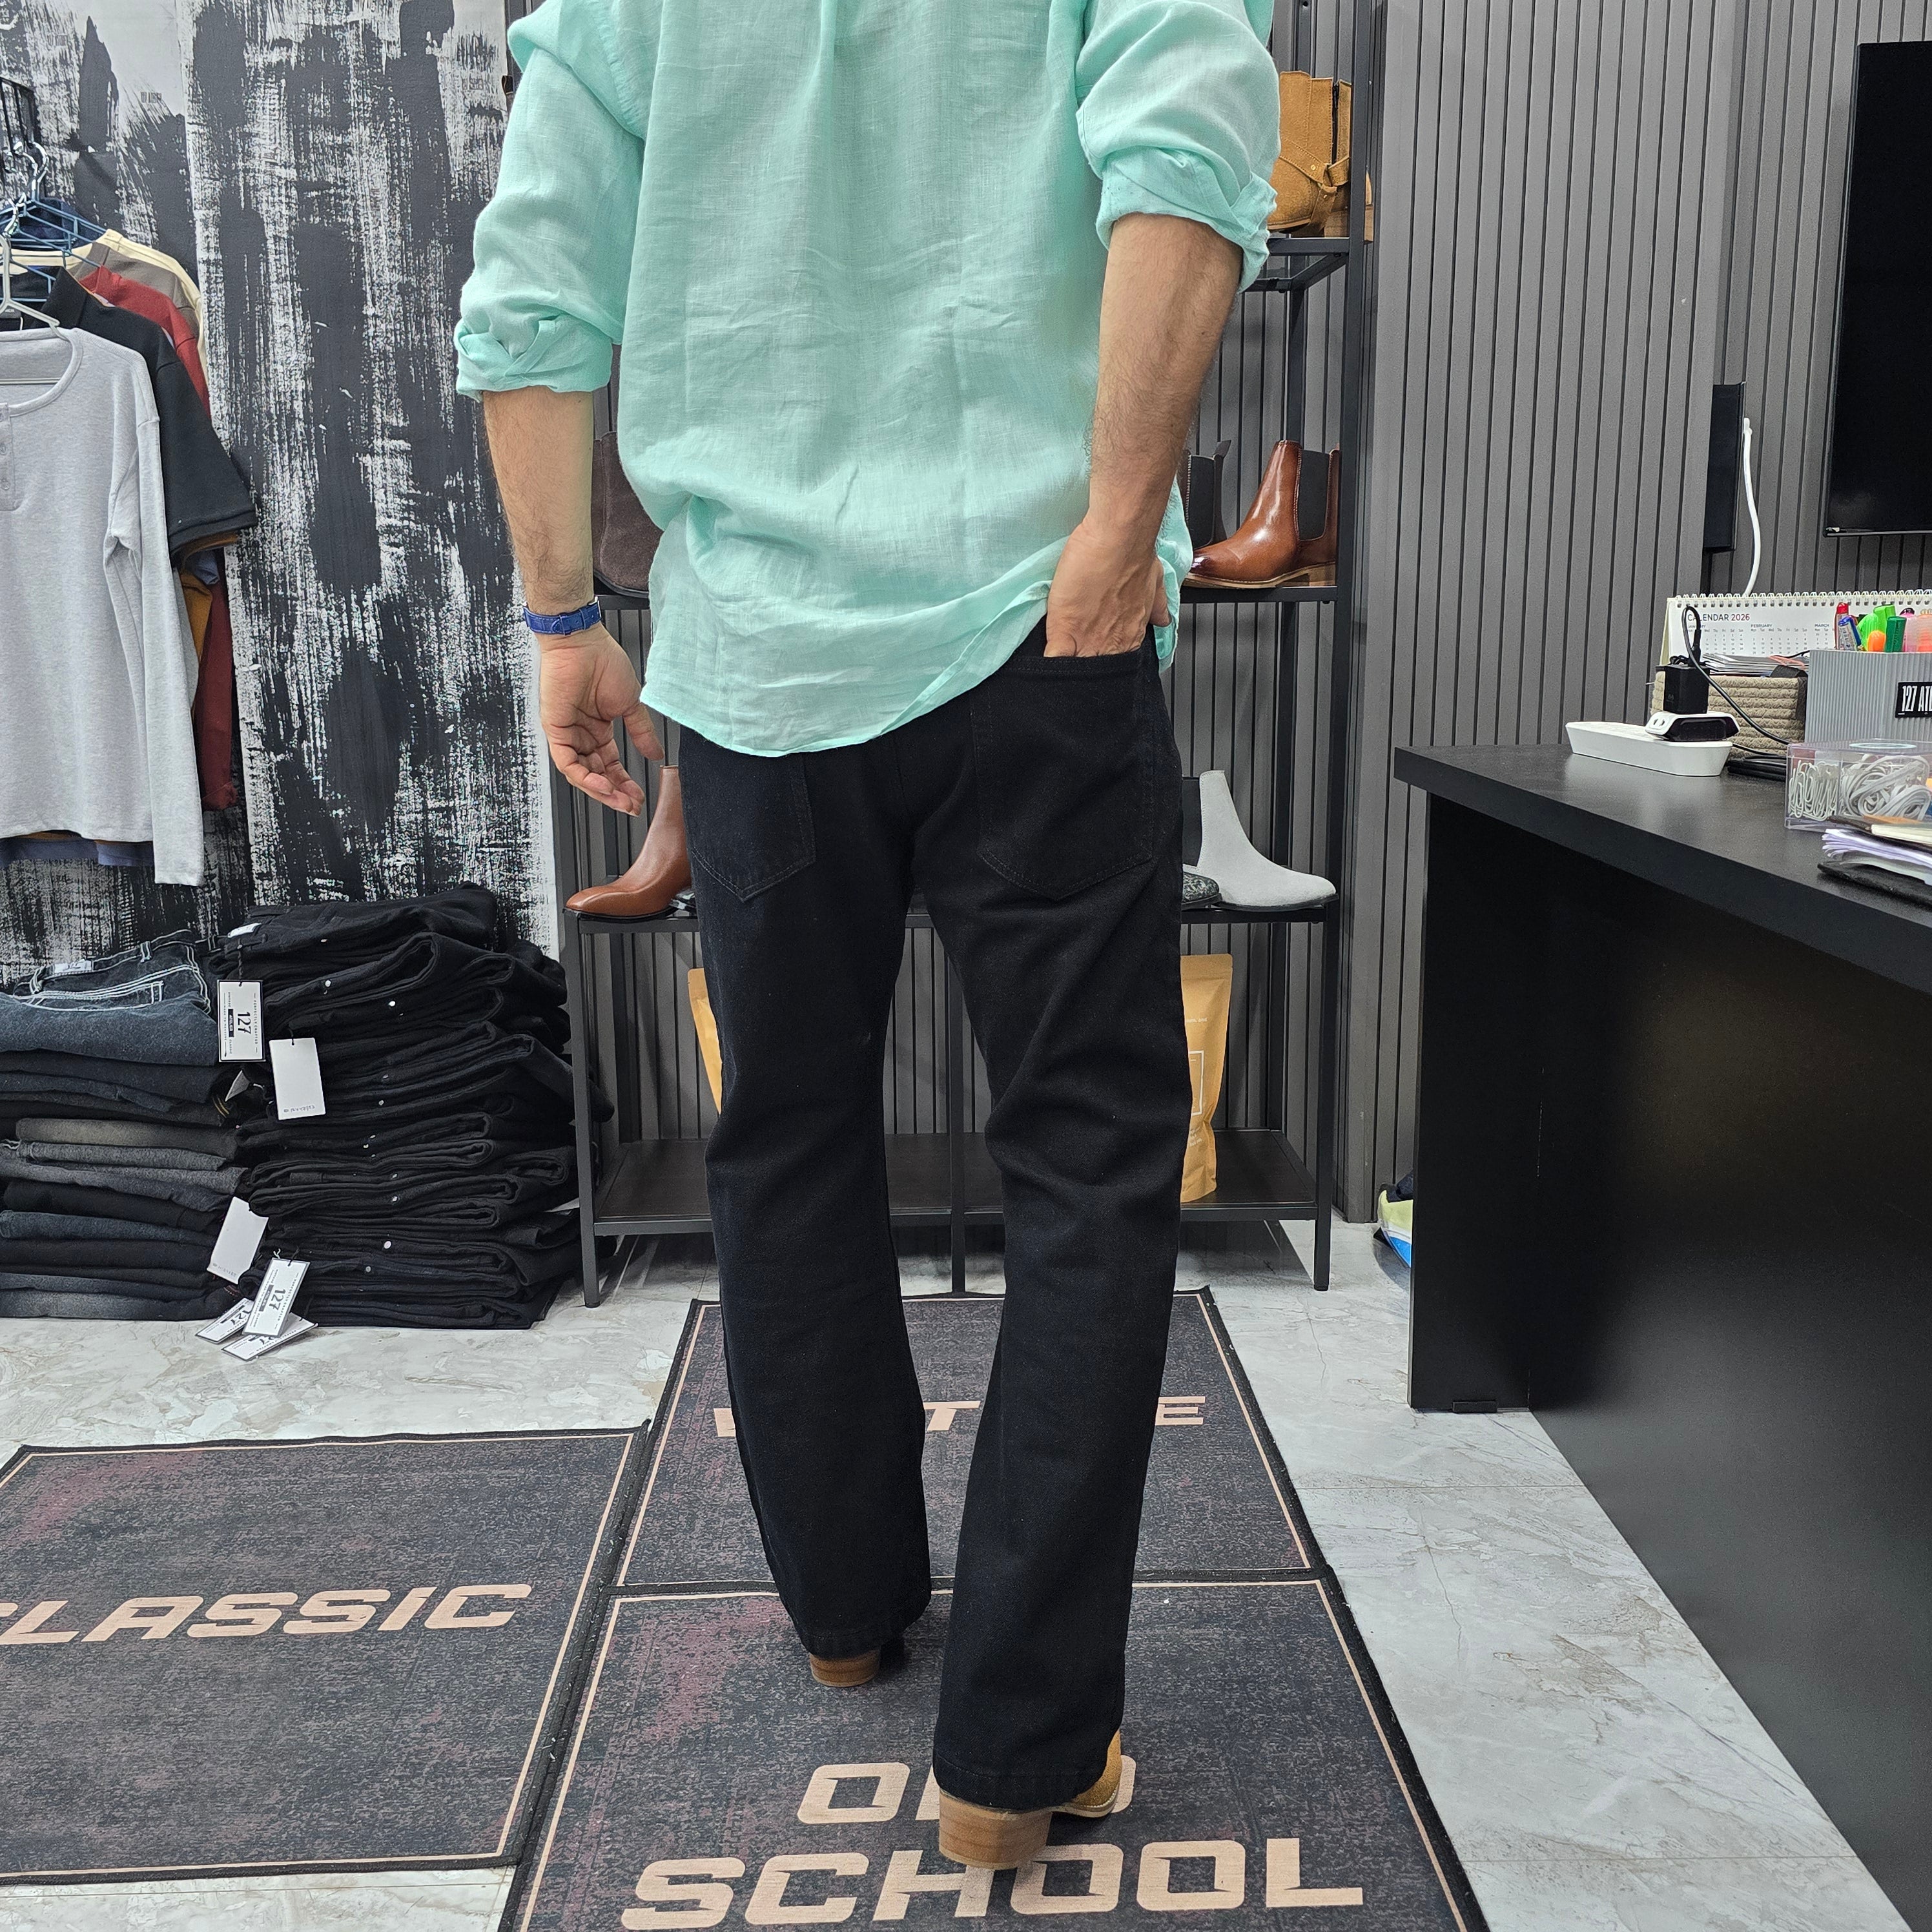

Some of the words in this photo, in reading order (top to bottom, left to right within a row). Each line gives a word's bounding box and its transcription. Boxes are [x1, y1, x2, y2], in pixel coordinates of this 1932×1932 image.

[1902, 686, 1918, 712] 127
[238, 1011, 251, 1034] 127
[269, 1289, 286, 1310] 127
[231, 1310, 251, 1326] 127
[0, 1584, 531, 1645] LASSIC
[621, 1838, 1364, 1931] SCHOOL
